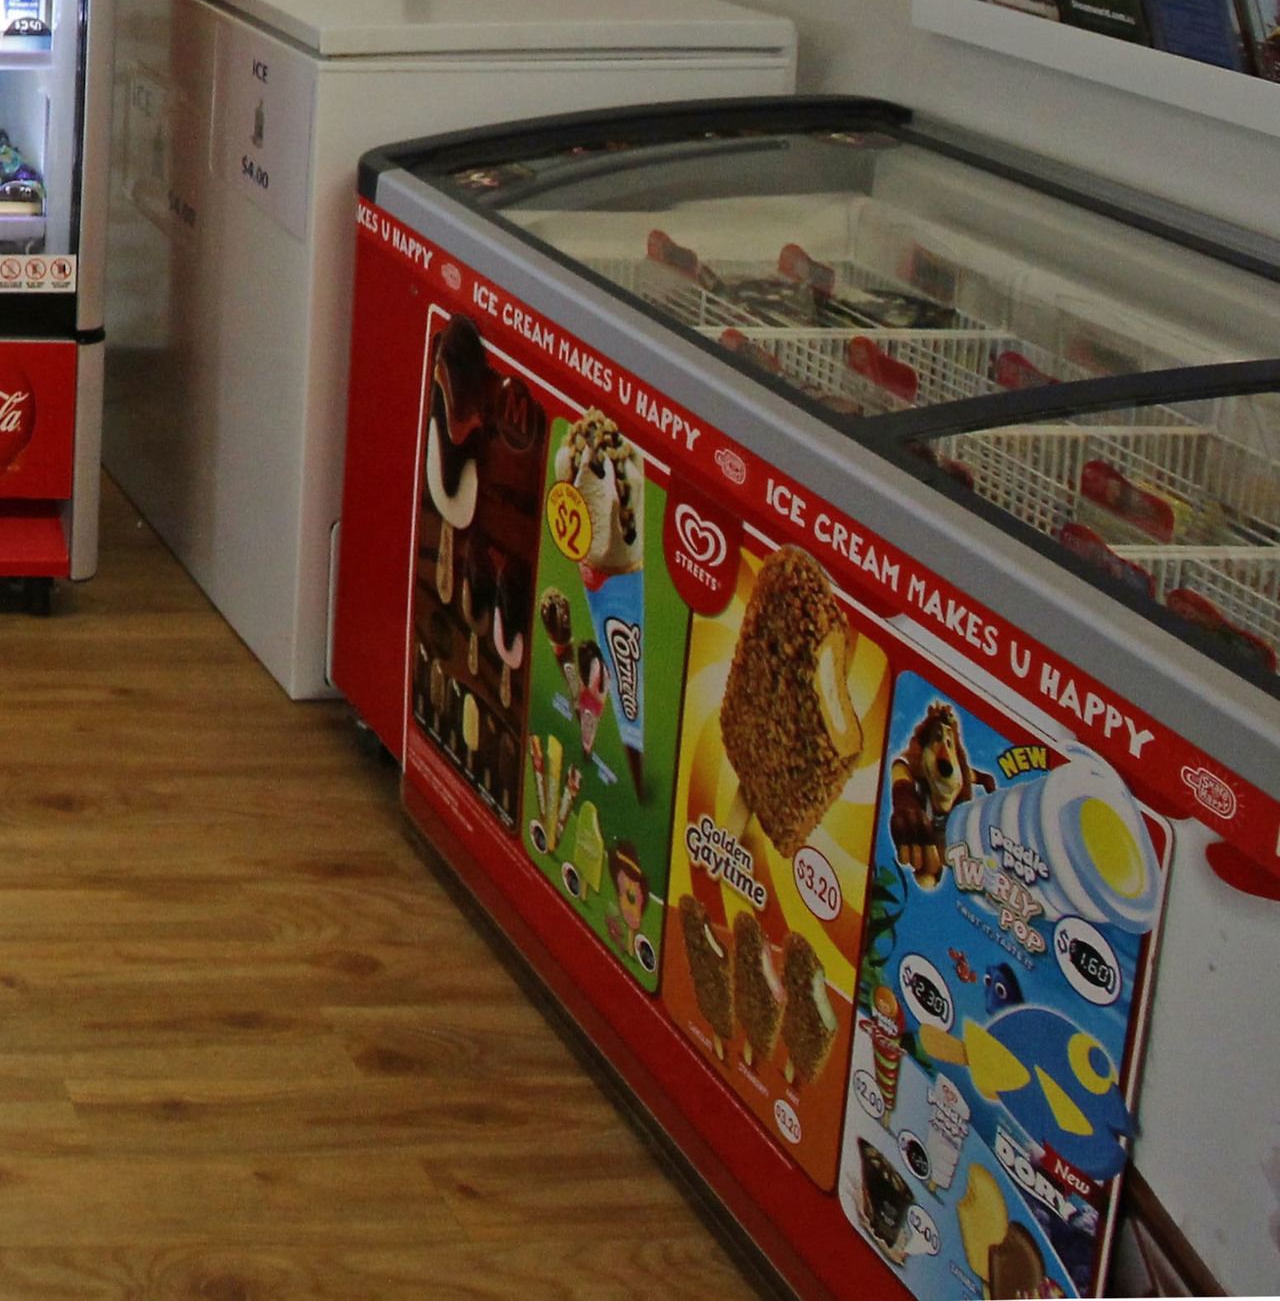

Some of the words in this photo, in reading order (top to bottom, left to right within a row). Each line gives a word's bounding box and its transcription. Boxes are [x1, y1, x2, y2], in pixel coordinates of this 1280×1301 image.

[252, 58, 268, 85] ICE
[241, 155, 269, 190] $4.00
[382, 219, 391, 241] U
[392, 227, 433, 270] HAPPY
[473, 282, 499, 318] ICE
[502, 303, 555, 355] CREAM
[558, 343, 613, 392] MAKES
[619, 380, 632, 405] U
[635, 390, 701, 451] HAPPY
[554, 503, 581, 554] $2
[674, 550, 719, 592] STREETS
[765, 478, 806, 528] ICE
[814, 513, 900, 592] CREAM
[907, 574, 999, 658] MAKES
[1010, 641, 1031, 679] U
[1039, 663, 1155, 760] HAPPY
[604, 616, 641, 723] Cornetto
[997, 745, 1048, 780] NEW
[685, 826, 767, 907] Gaytime
[700, 817, 753, 871] Golden
[989, 825, 1050, 880] Paddle
[795, 858, 839, 912] $3.20
[1000, 907, 1047, 955] POP
[995, 1126, 1078, 1223] DORY
[1055, 1157, 1092, 1195] New
